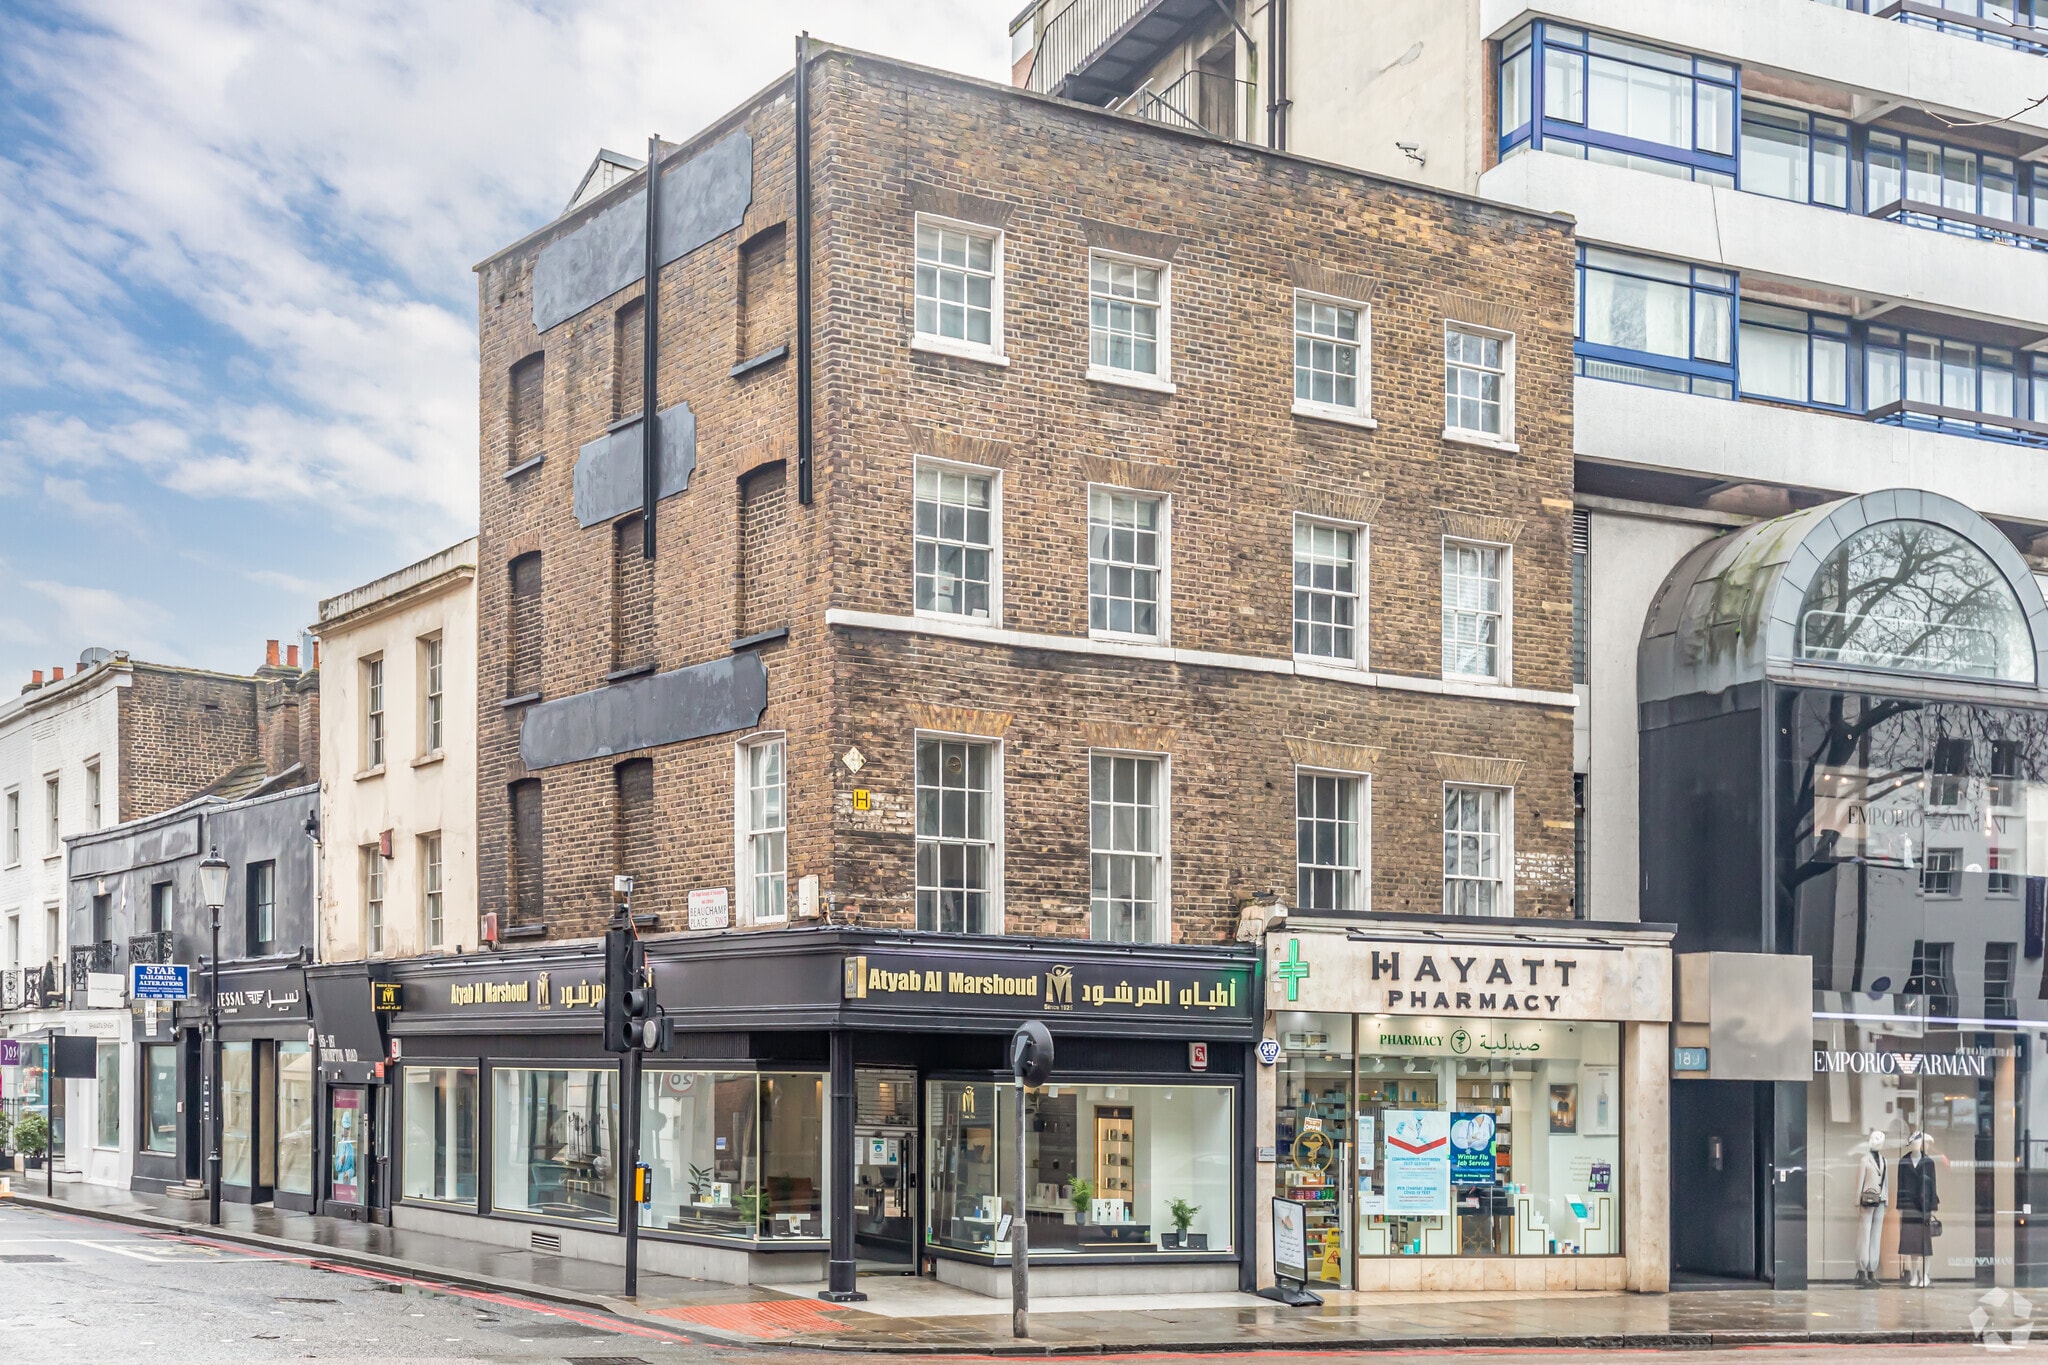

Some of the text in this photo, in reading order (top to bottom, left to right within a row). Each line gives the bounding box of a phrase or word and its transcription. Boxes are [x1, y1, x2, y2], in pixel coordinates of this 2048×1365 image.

[856, 791, 868, 808] H
[1848, 805, 1923, 829] EMPORIO
[690, 904, 727, 917] BEAUCHAMP
[690, 916, 727, 928] PLACE SW3
[146, 966, 176, 975] STAR
[1371, 951, 1577, 987] HAYATT
[450, 980, 528, 1006] Atyab Al Marshoud
[868, 968, 1038, 996] Atyab Al Marshoud
[1081, 978, 1237, 1010] أطياب المرشود
[1388, 989, 1561, 1012] PHARMACY
[1379, 1033, 1444, 1047] PHARMACY
[1479, 1033, 1540, 1055] صيدلية
[1814, 1050, 1986, 1077] EMPORIO ARMANI
